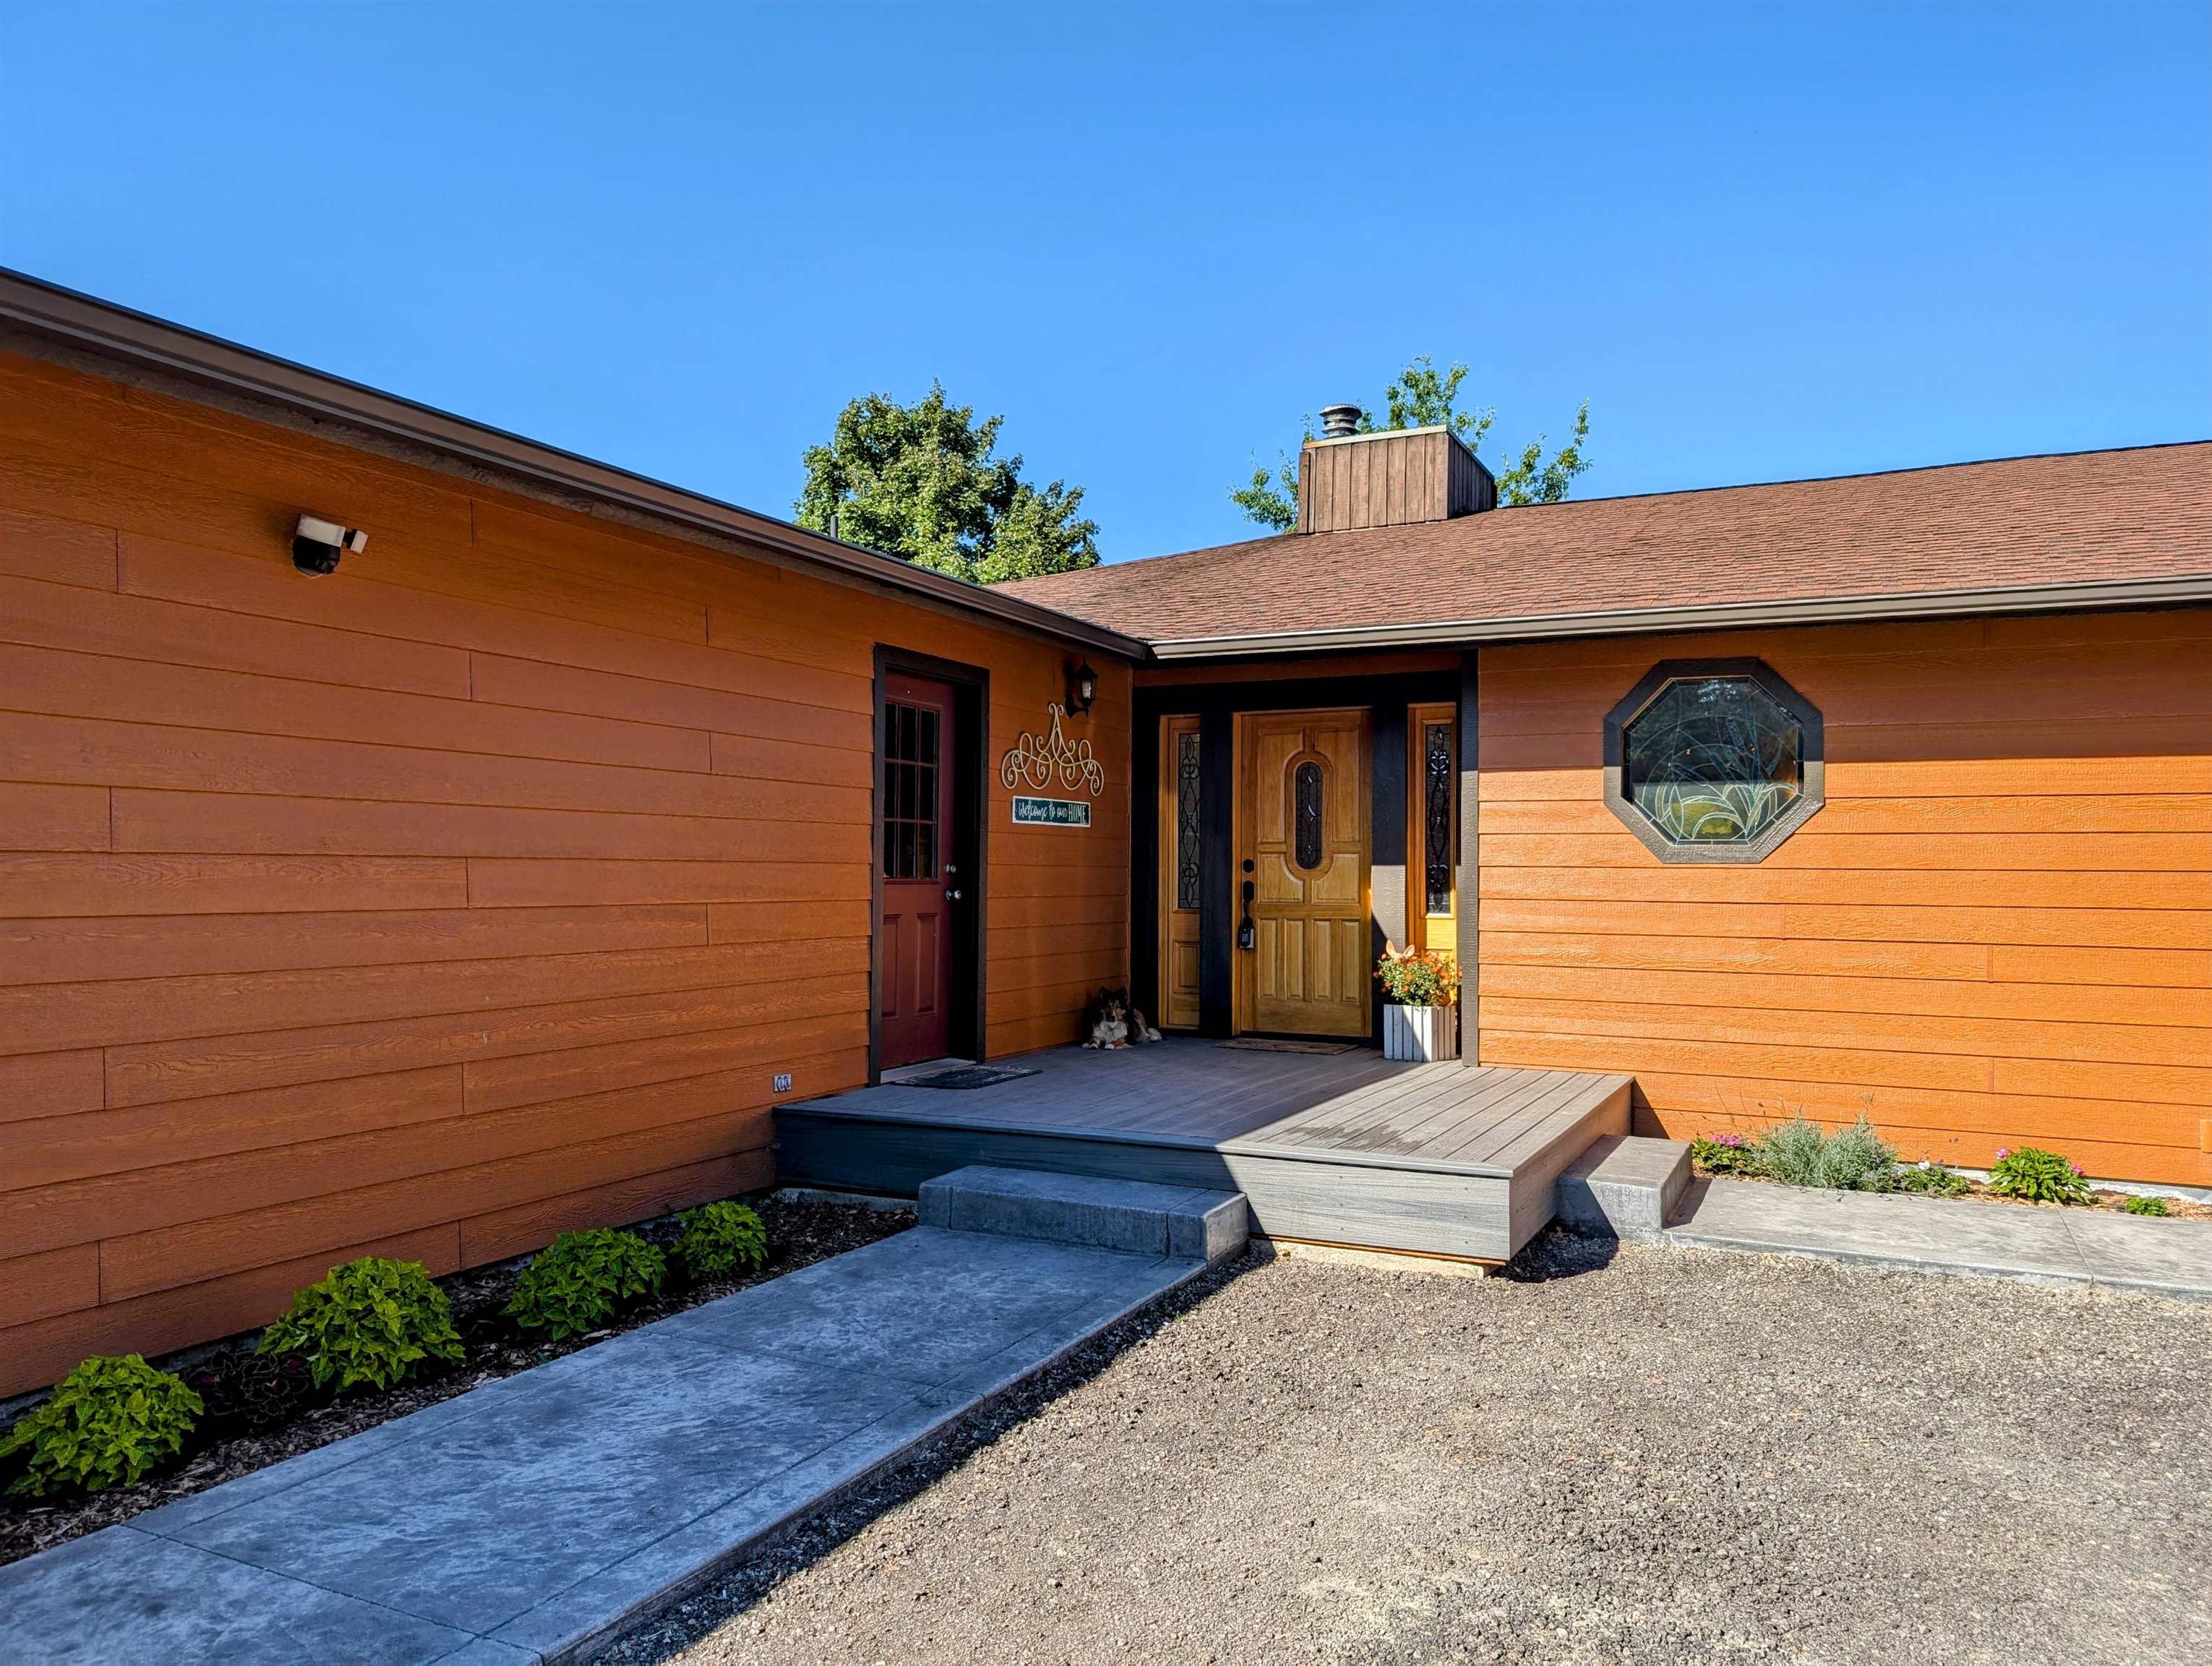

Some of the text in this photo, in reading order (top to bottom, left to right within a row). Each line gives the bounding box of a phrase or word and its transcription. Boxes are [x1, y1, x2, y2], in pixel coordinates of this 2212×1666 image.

[1049, 801, 1055, 820] to
[1057, 806, 1068, 818] our
[1068, 804, 1086, 822] HOME
